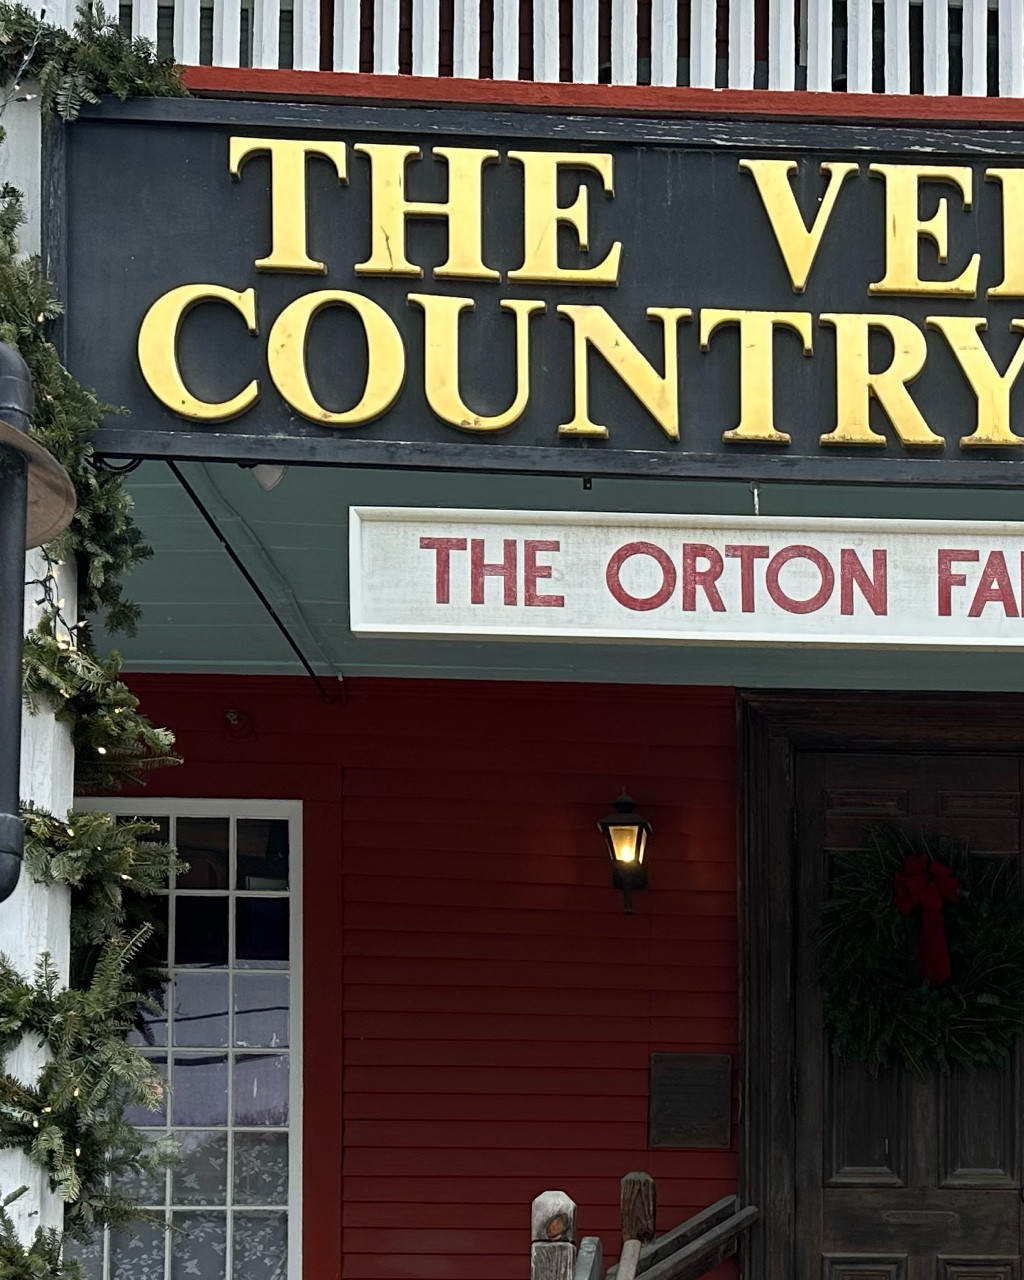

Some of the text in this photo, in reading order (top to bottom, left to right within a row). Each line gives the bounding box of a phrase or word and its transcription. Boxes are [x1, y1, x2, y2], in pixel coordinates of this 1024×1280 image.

[229, 136, 622, 285] THE
[420, 537, 565, 608] THE
[606, 541, 888, 616] ORTON
